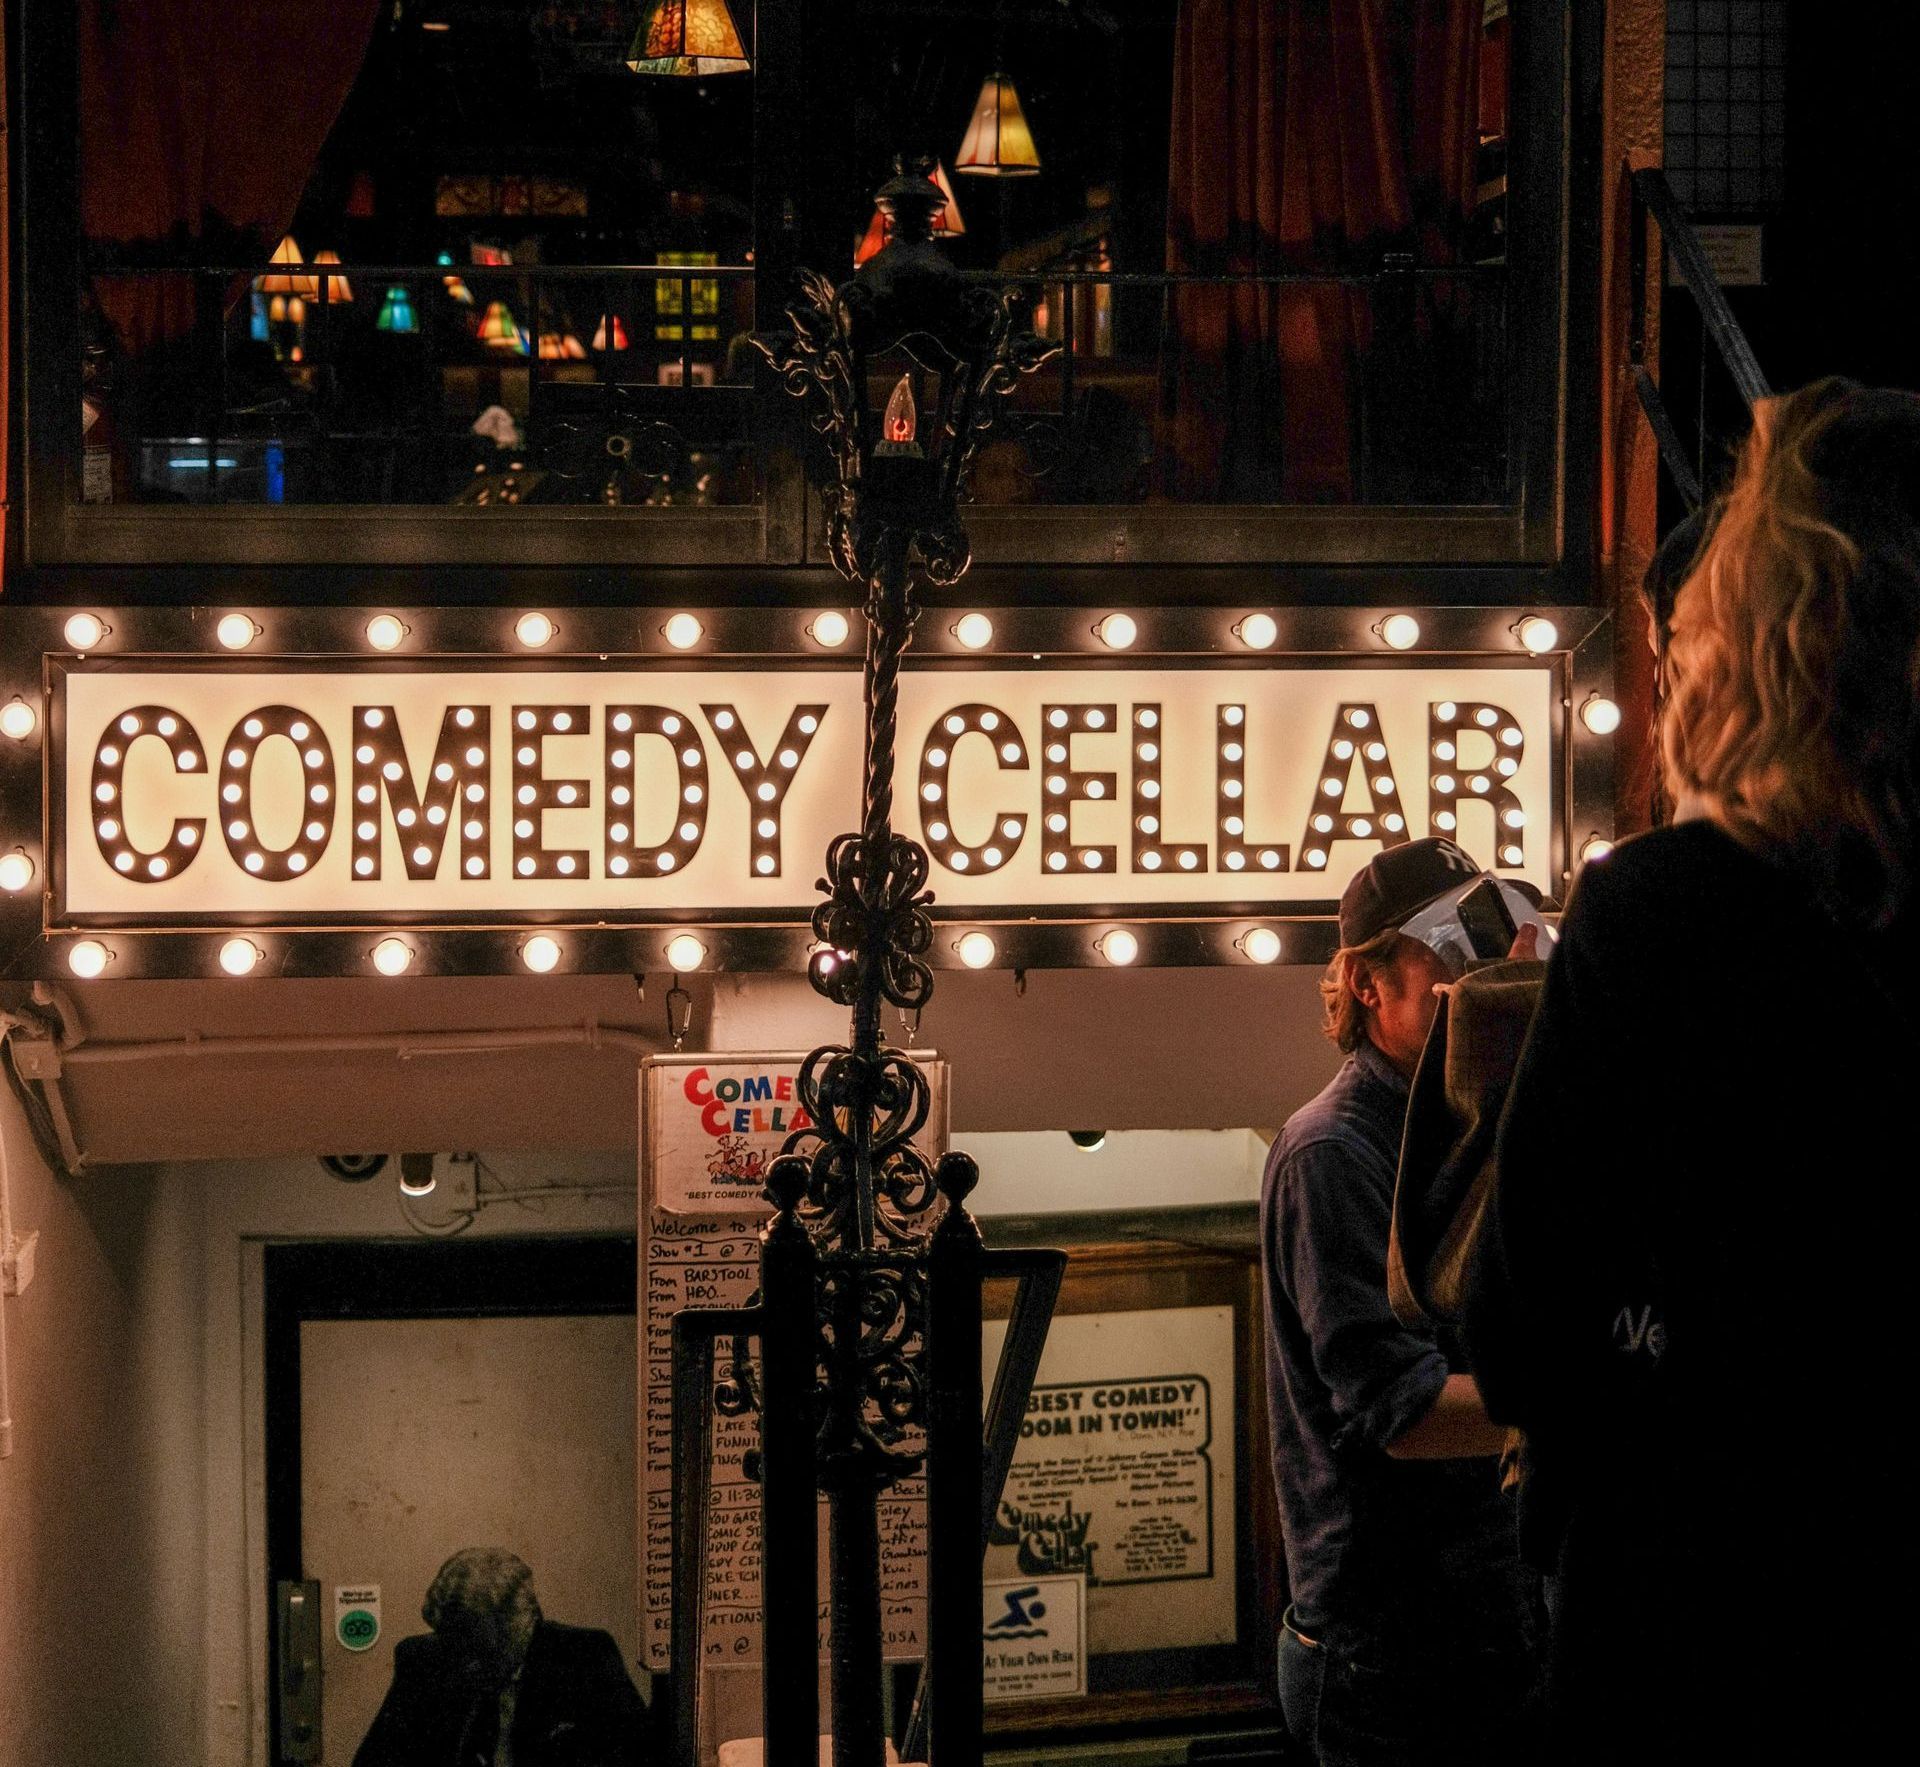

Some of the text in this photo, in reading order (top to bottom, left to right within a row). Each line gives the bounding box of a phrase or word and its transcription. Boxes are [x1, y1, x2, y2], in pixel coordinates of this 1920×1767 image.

[91, 702, 1526, 884] COMEDY CELLAR
[701, 1100, 812, 1137] CELLA
[715, 1191, 753, 1199] COMEDY
[651, 1216, 720, 1236] Welcome
[730, 1220, 746, 1233] to
[720, 1244, 734, 1257] @
[649, 1268, 752, 1287] From BARSTOOL
[647, 1291, 676, 1303] From
[1027, 1384, 1197, 1413] BEST COMEDY
[1020, 1417, 1072, 1438] OOM
[1079, 1414, 1103, 1434] IN
[709, 1611, 762, 1625] ATIONS
